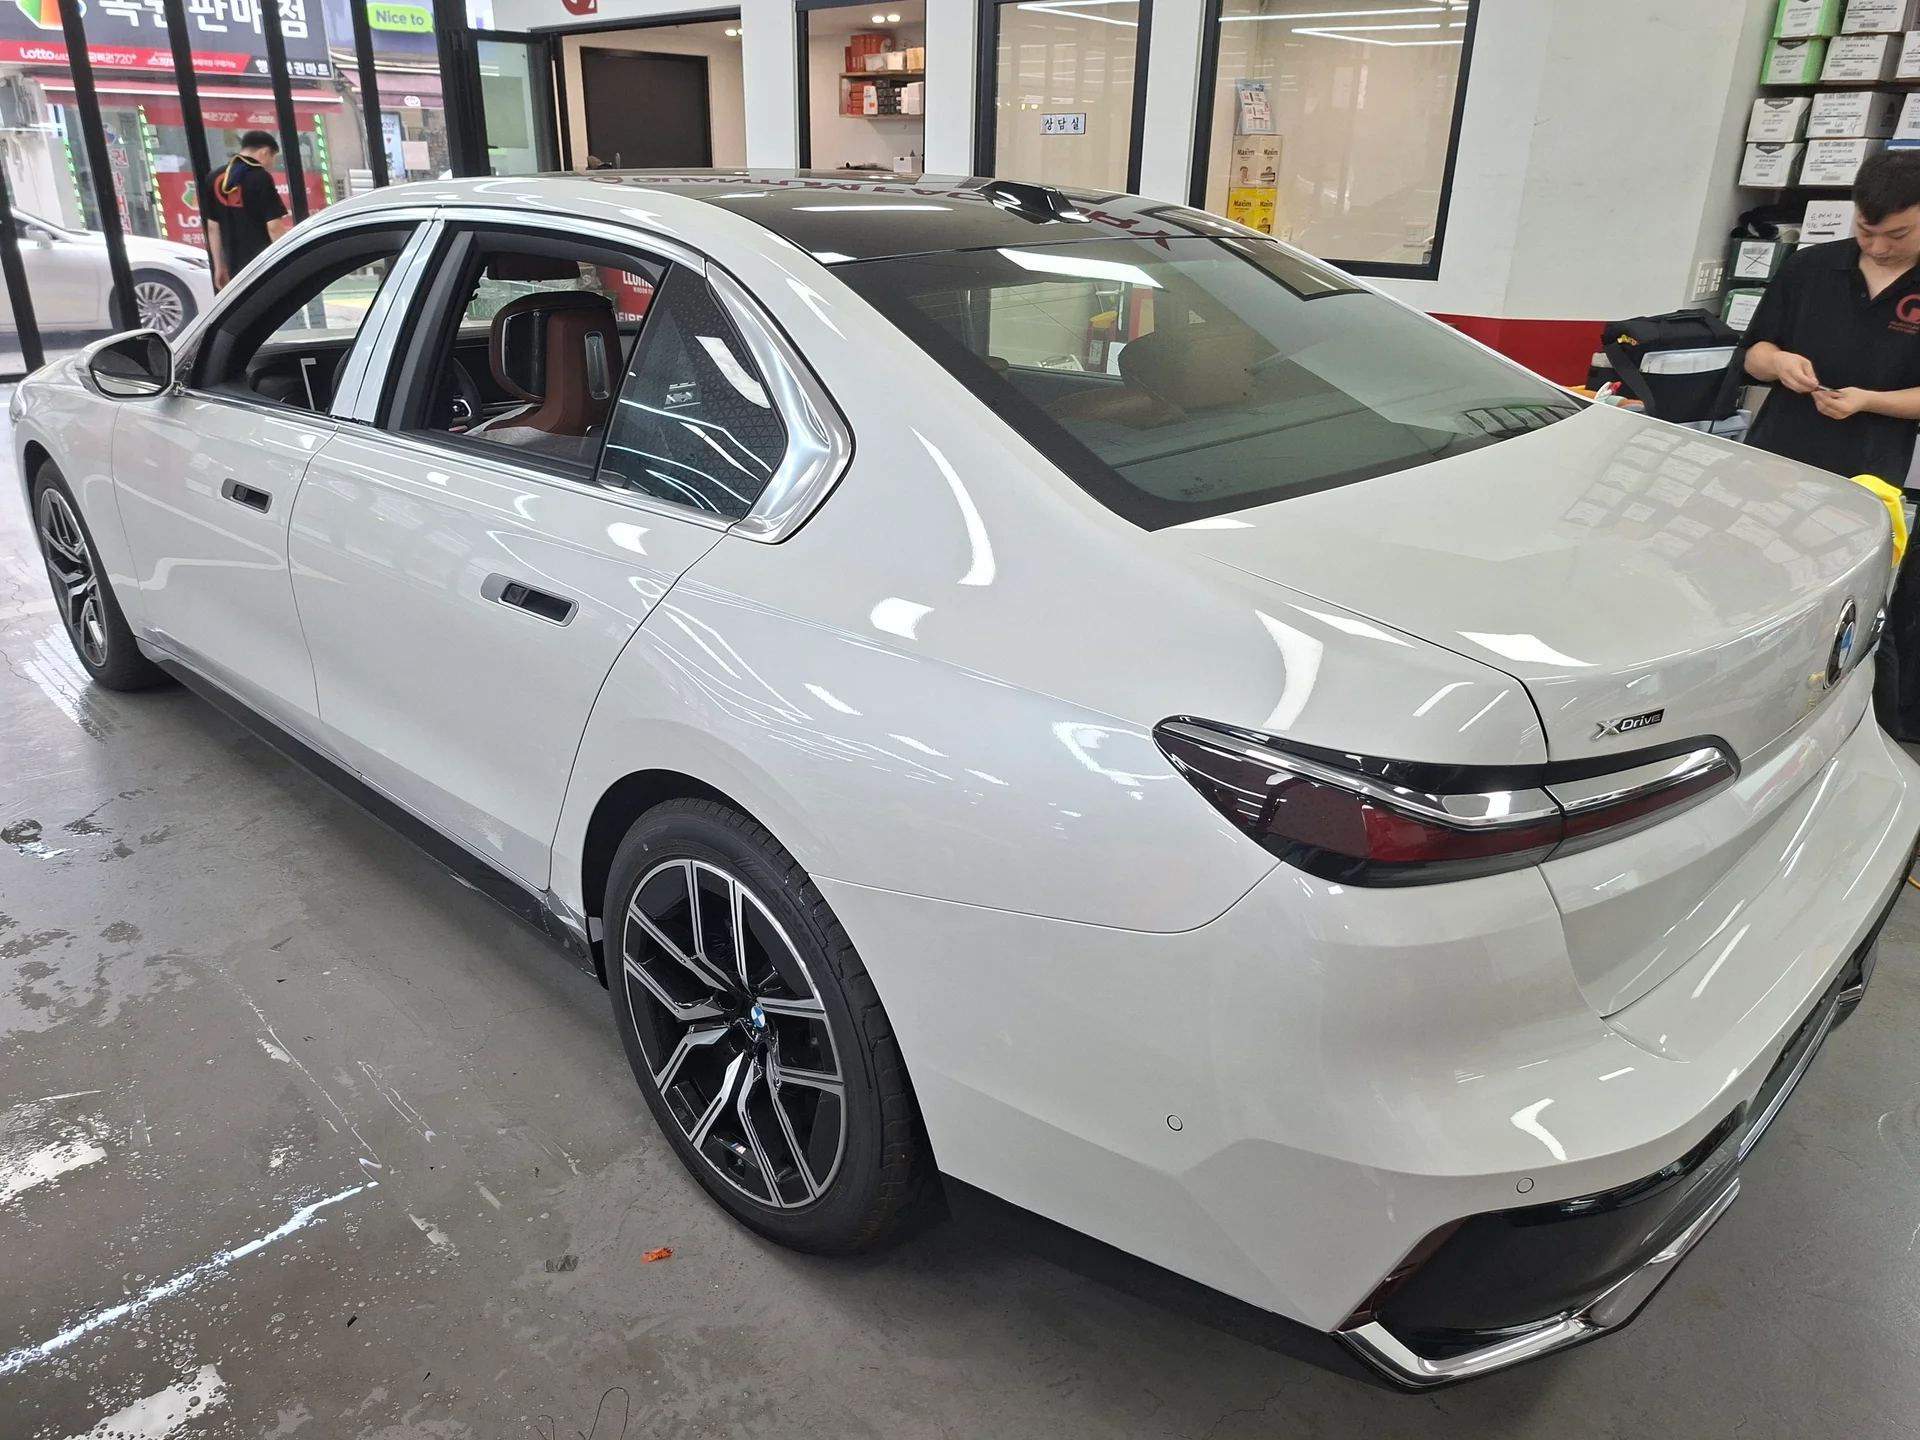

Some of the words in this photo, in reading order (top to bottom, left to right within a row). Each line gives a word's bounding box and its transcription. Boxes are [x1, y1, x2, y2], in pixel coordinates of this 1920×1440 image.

[375, 10, 407, 24] Nice
[410, 14, 424, 26] to
[20, 47, 55, 60] Lotto
[1045, 117, 1079, 131] 상담실
